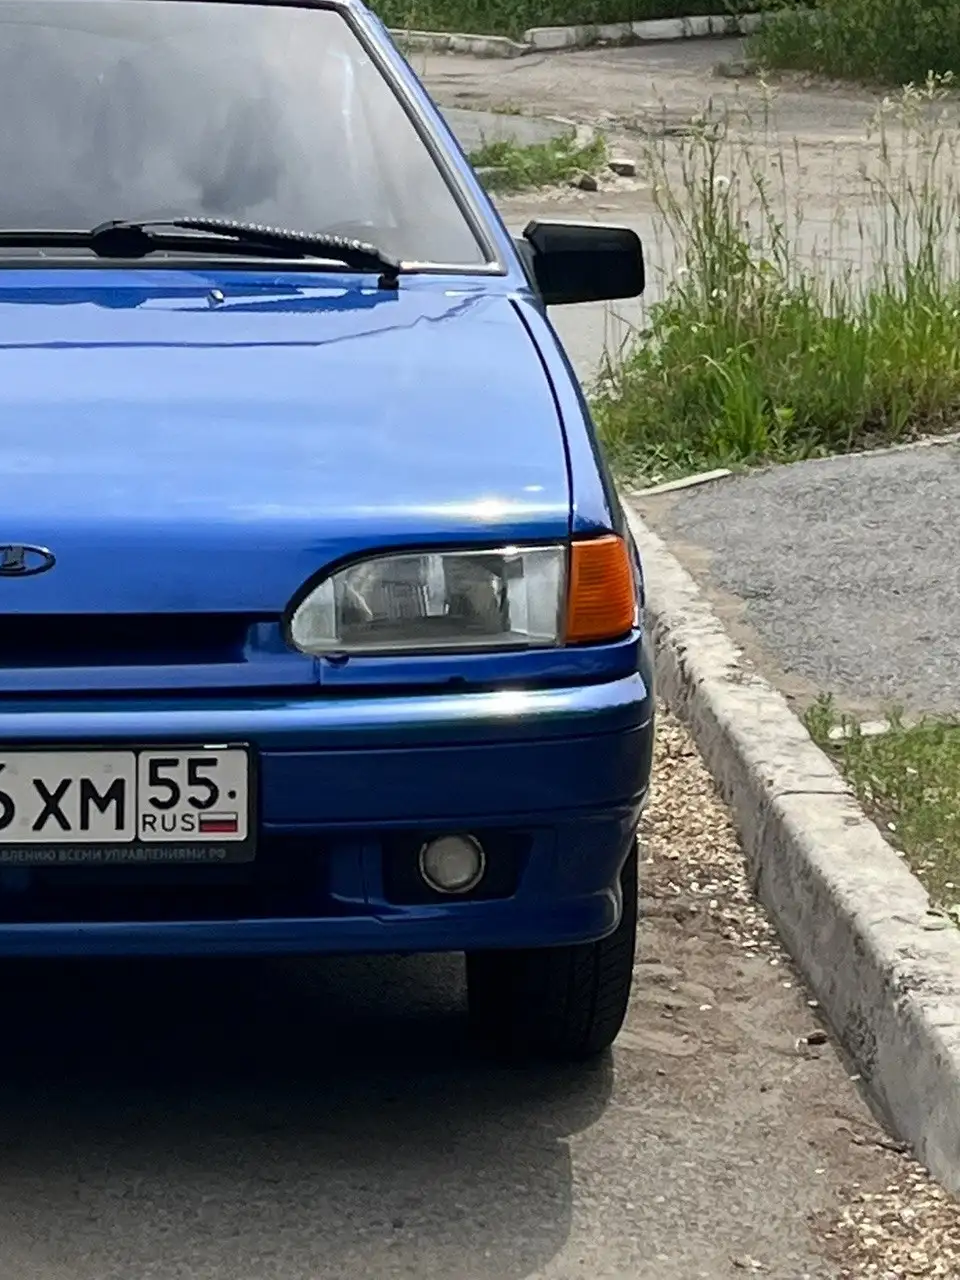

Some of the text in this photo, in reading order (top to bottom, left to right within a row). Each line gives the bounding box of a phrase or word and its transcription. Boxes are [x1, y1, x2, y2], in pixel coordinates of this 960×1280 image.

[148, 757, 219, 810] 55
[141, 813, 196, 832] RUS
[58, 848, 103, 861] ВСЕМИ
[104, 847, 206, 861] УПРАВЛЕНИЯМИ
[208, 847, 227, 860] РФ
